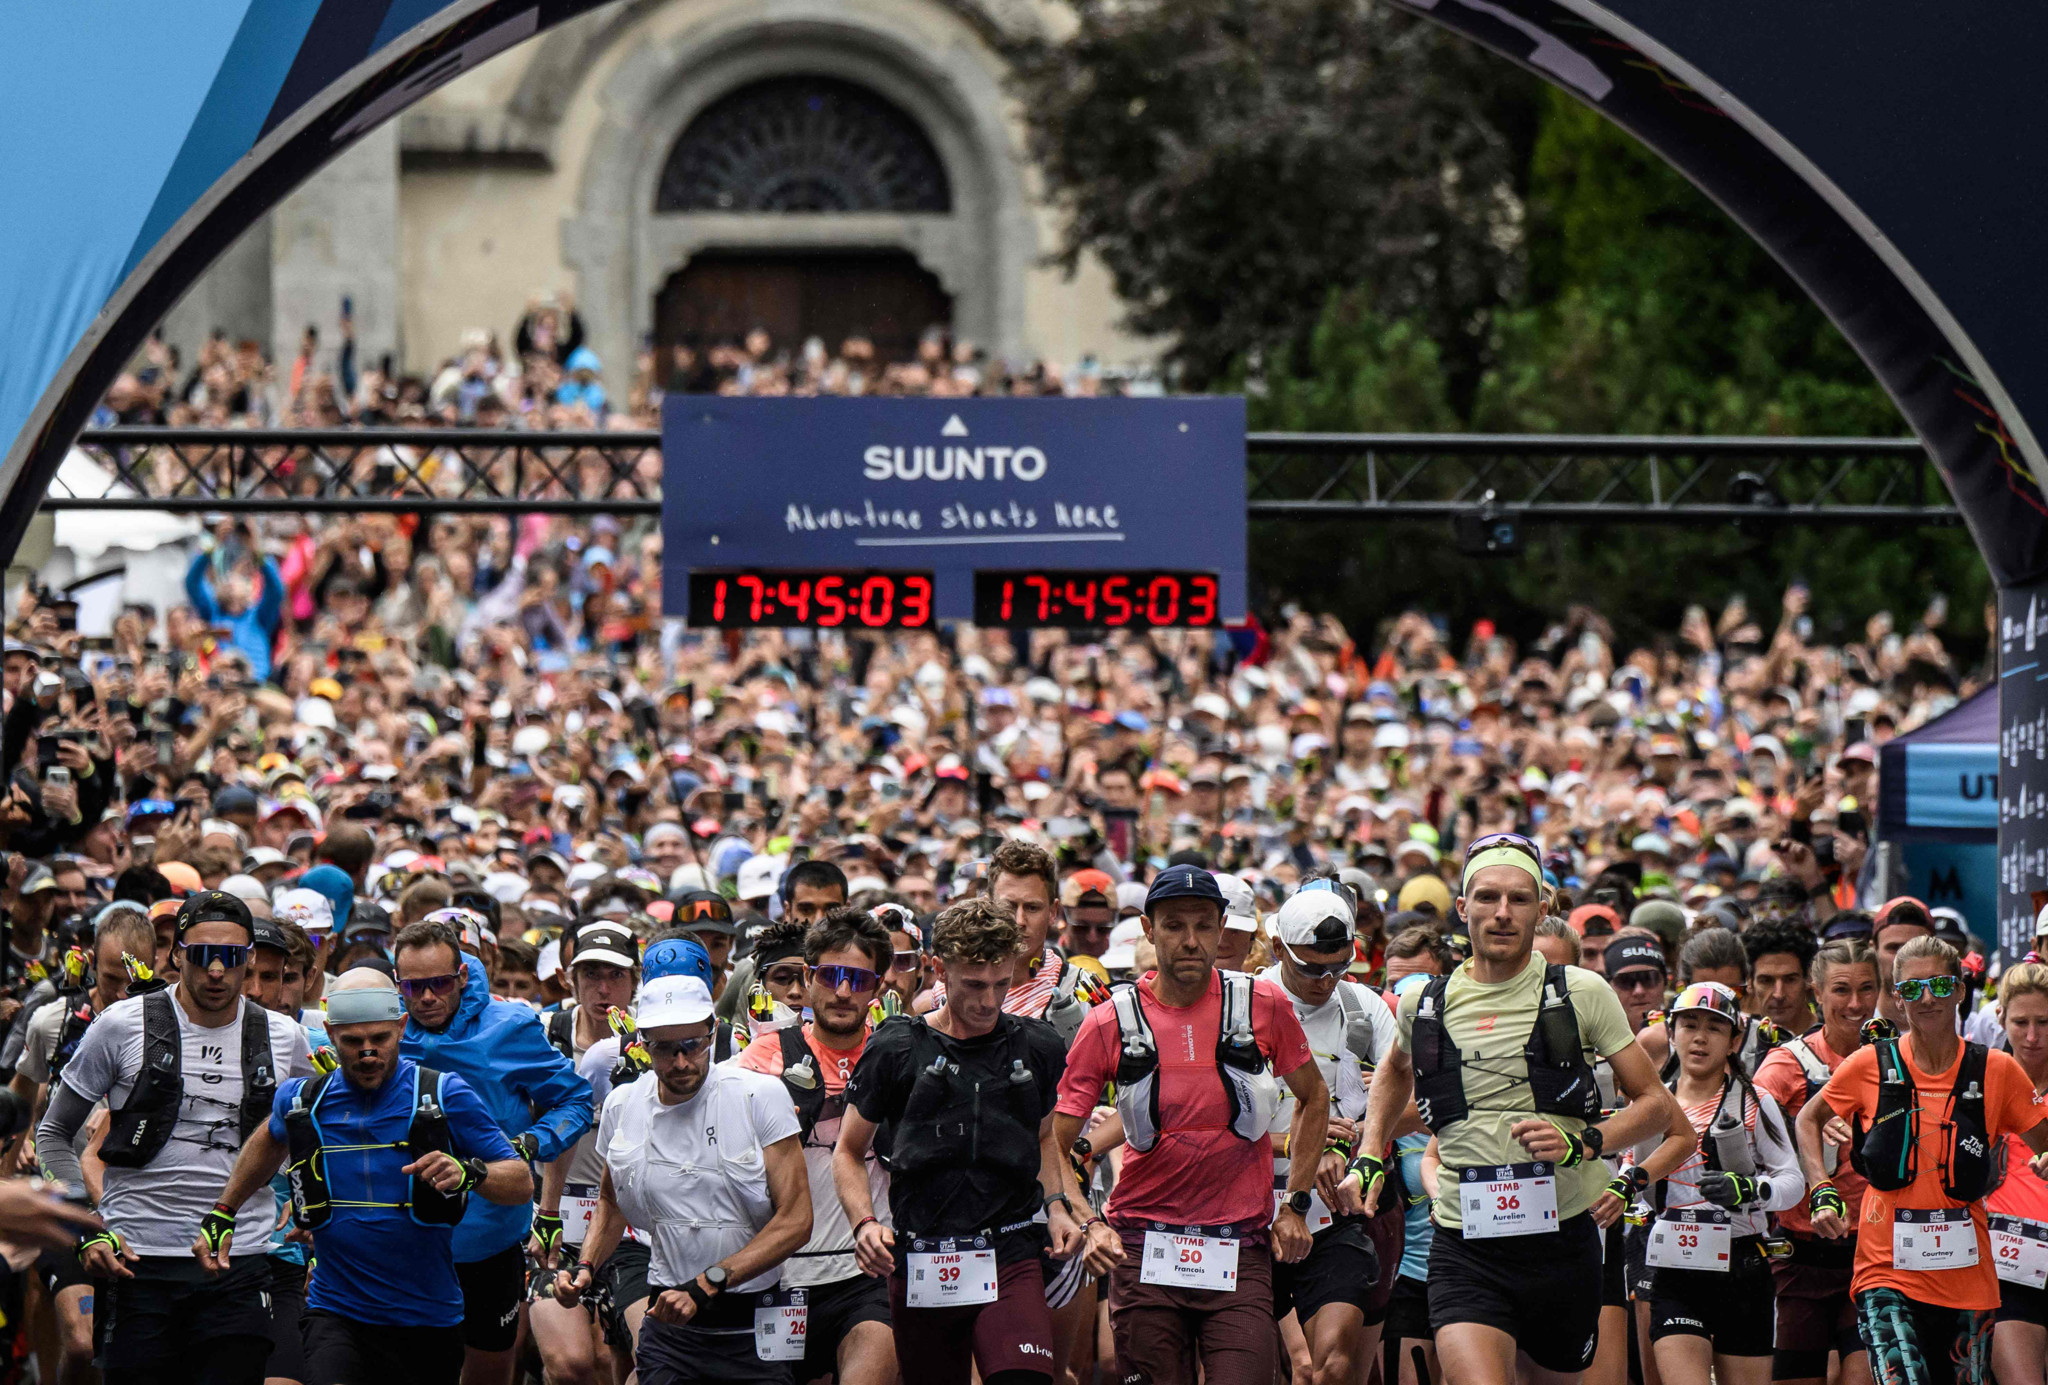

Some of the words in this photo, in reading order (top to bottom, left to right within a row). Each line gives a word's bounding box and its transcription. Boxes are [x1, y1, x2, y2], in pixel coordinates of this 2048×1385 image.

[863, 446, 1047, 481] SUUNTO
[941, 501, 1038, 530] starts
[713, 575, 931, 627] 17:45:03
[1001, 575, 1217, 626] 17:45:03
[1622, 947, 1665, 961] SUUNT
[1187, 1024, 1195, 1061] SALOMON
[132, 1118, 148, 1146] SILVA
[1970, 1135, 1984, 1150] The
[1490, 1182, 1520, 1193] UTMB
[1496, 1195, 1520, 1211] 36
[1492, 1212, 1526, 1221] Aurelien
[1674, 1224, 1700, 1232] UTMB
[1923, 1224, 1950, 1233] UTMB
[1175, 1236, 1205, 1247] UTMB
[1678, 1235, 1698, 1248] 33
[1934, 1235, 1941, 1248] 1
[1999, 1233, 2024, 1246] UTMB
[933, 1254, 961, 1264] UTMB
[1179, 1249, 1202, 1264] 50
[1999, 1246, 2020, 1261] 62
[939, 1267, 960, 1282] 39
[1174, 1265, 1205, 1274] Francois
[941, 1284, 958, 1292] Théo
[790, 1320, 806, 1335] 26
[1674, 1317, 1703, 1329] TERREX
